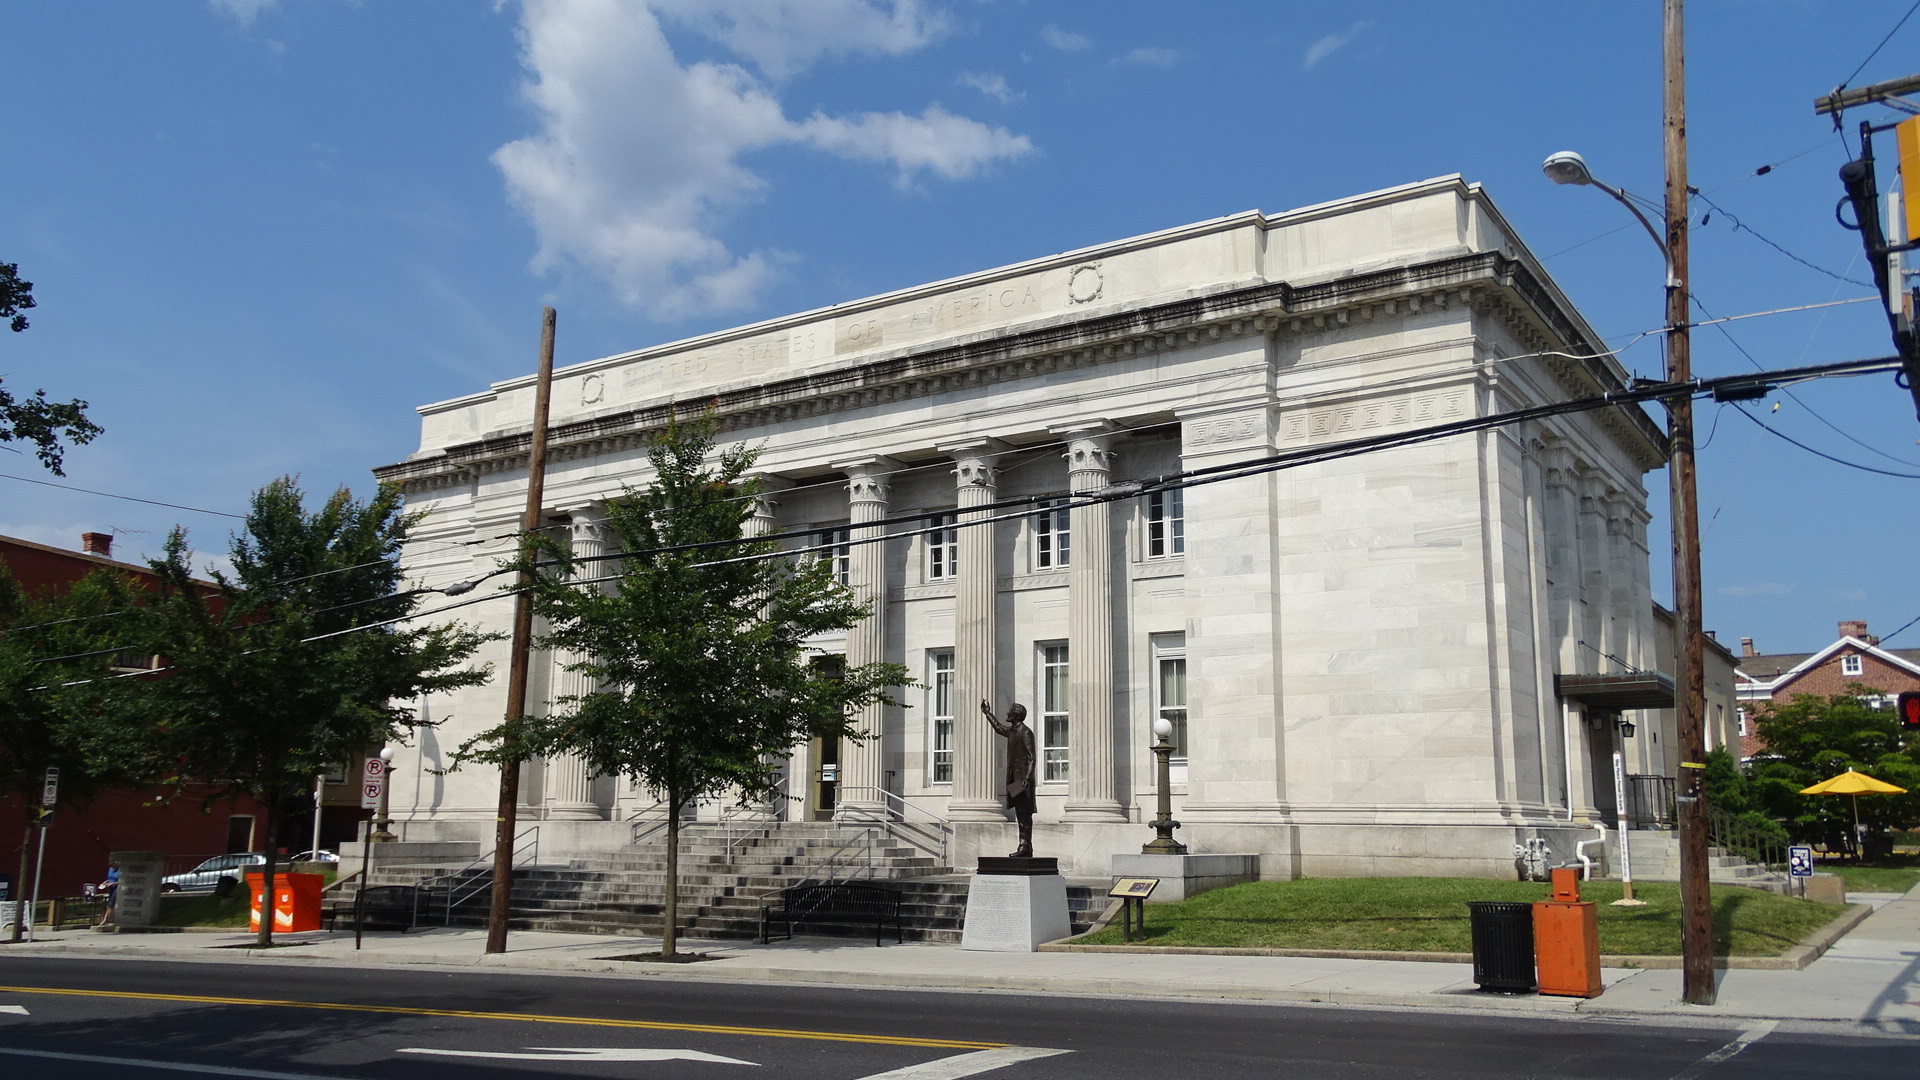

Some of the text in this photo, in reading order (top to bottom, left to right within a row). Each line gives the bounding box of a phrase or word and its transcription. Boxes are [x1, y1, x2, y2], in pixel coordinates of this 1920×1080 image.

[736, 332, 816, 365] STATES
[848, 319, 877, 341] OF
[909, 285, 1037, 329] AMERICA
